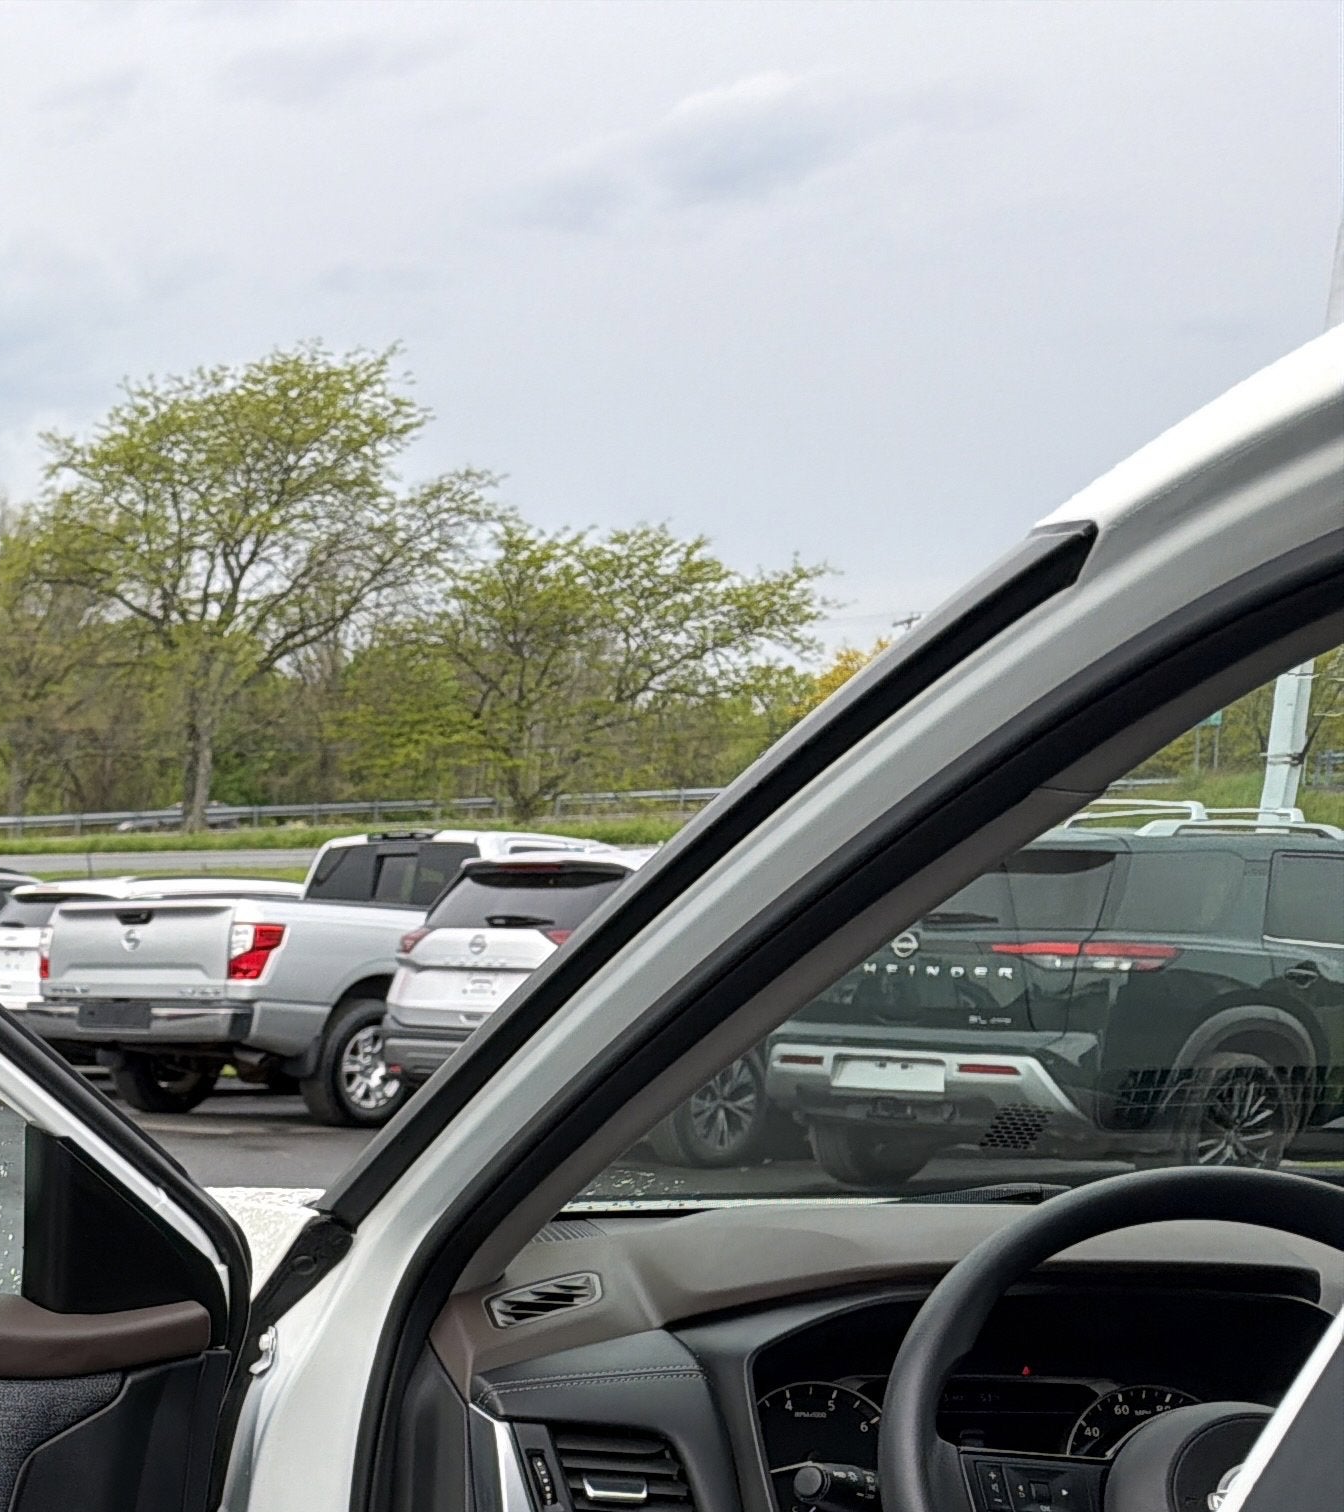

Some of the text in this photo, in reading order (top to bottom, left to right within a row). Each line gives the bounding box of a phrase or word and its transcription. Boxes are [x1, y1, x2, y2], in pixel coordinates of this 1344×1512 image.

[784, 1399, 793, 1411] 4
[827, 1400, 836, 1412] 5
[1114, 1400, 1130, 1415] 60
[860, 1421, 869, 1433] 6
[1084, 1426, 1100, 1438] 40
